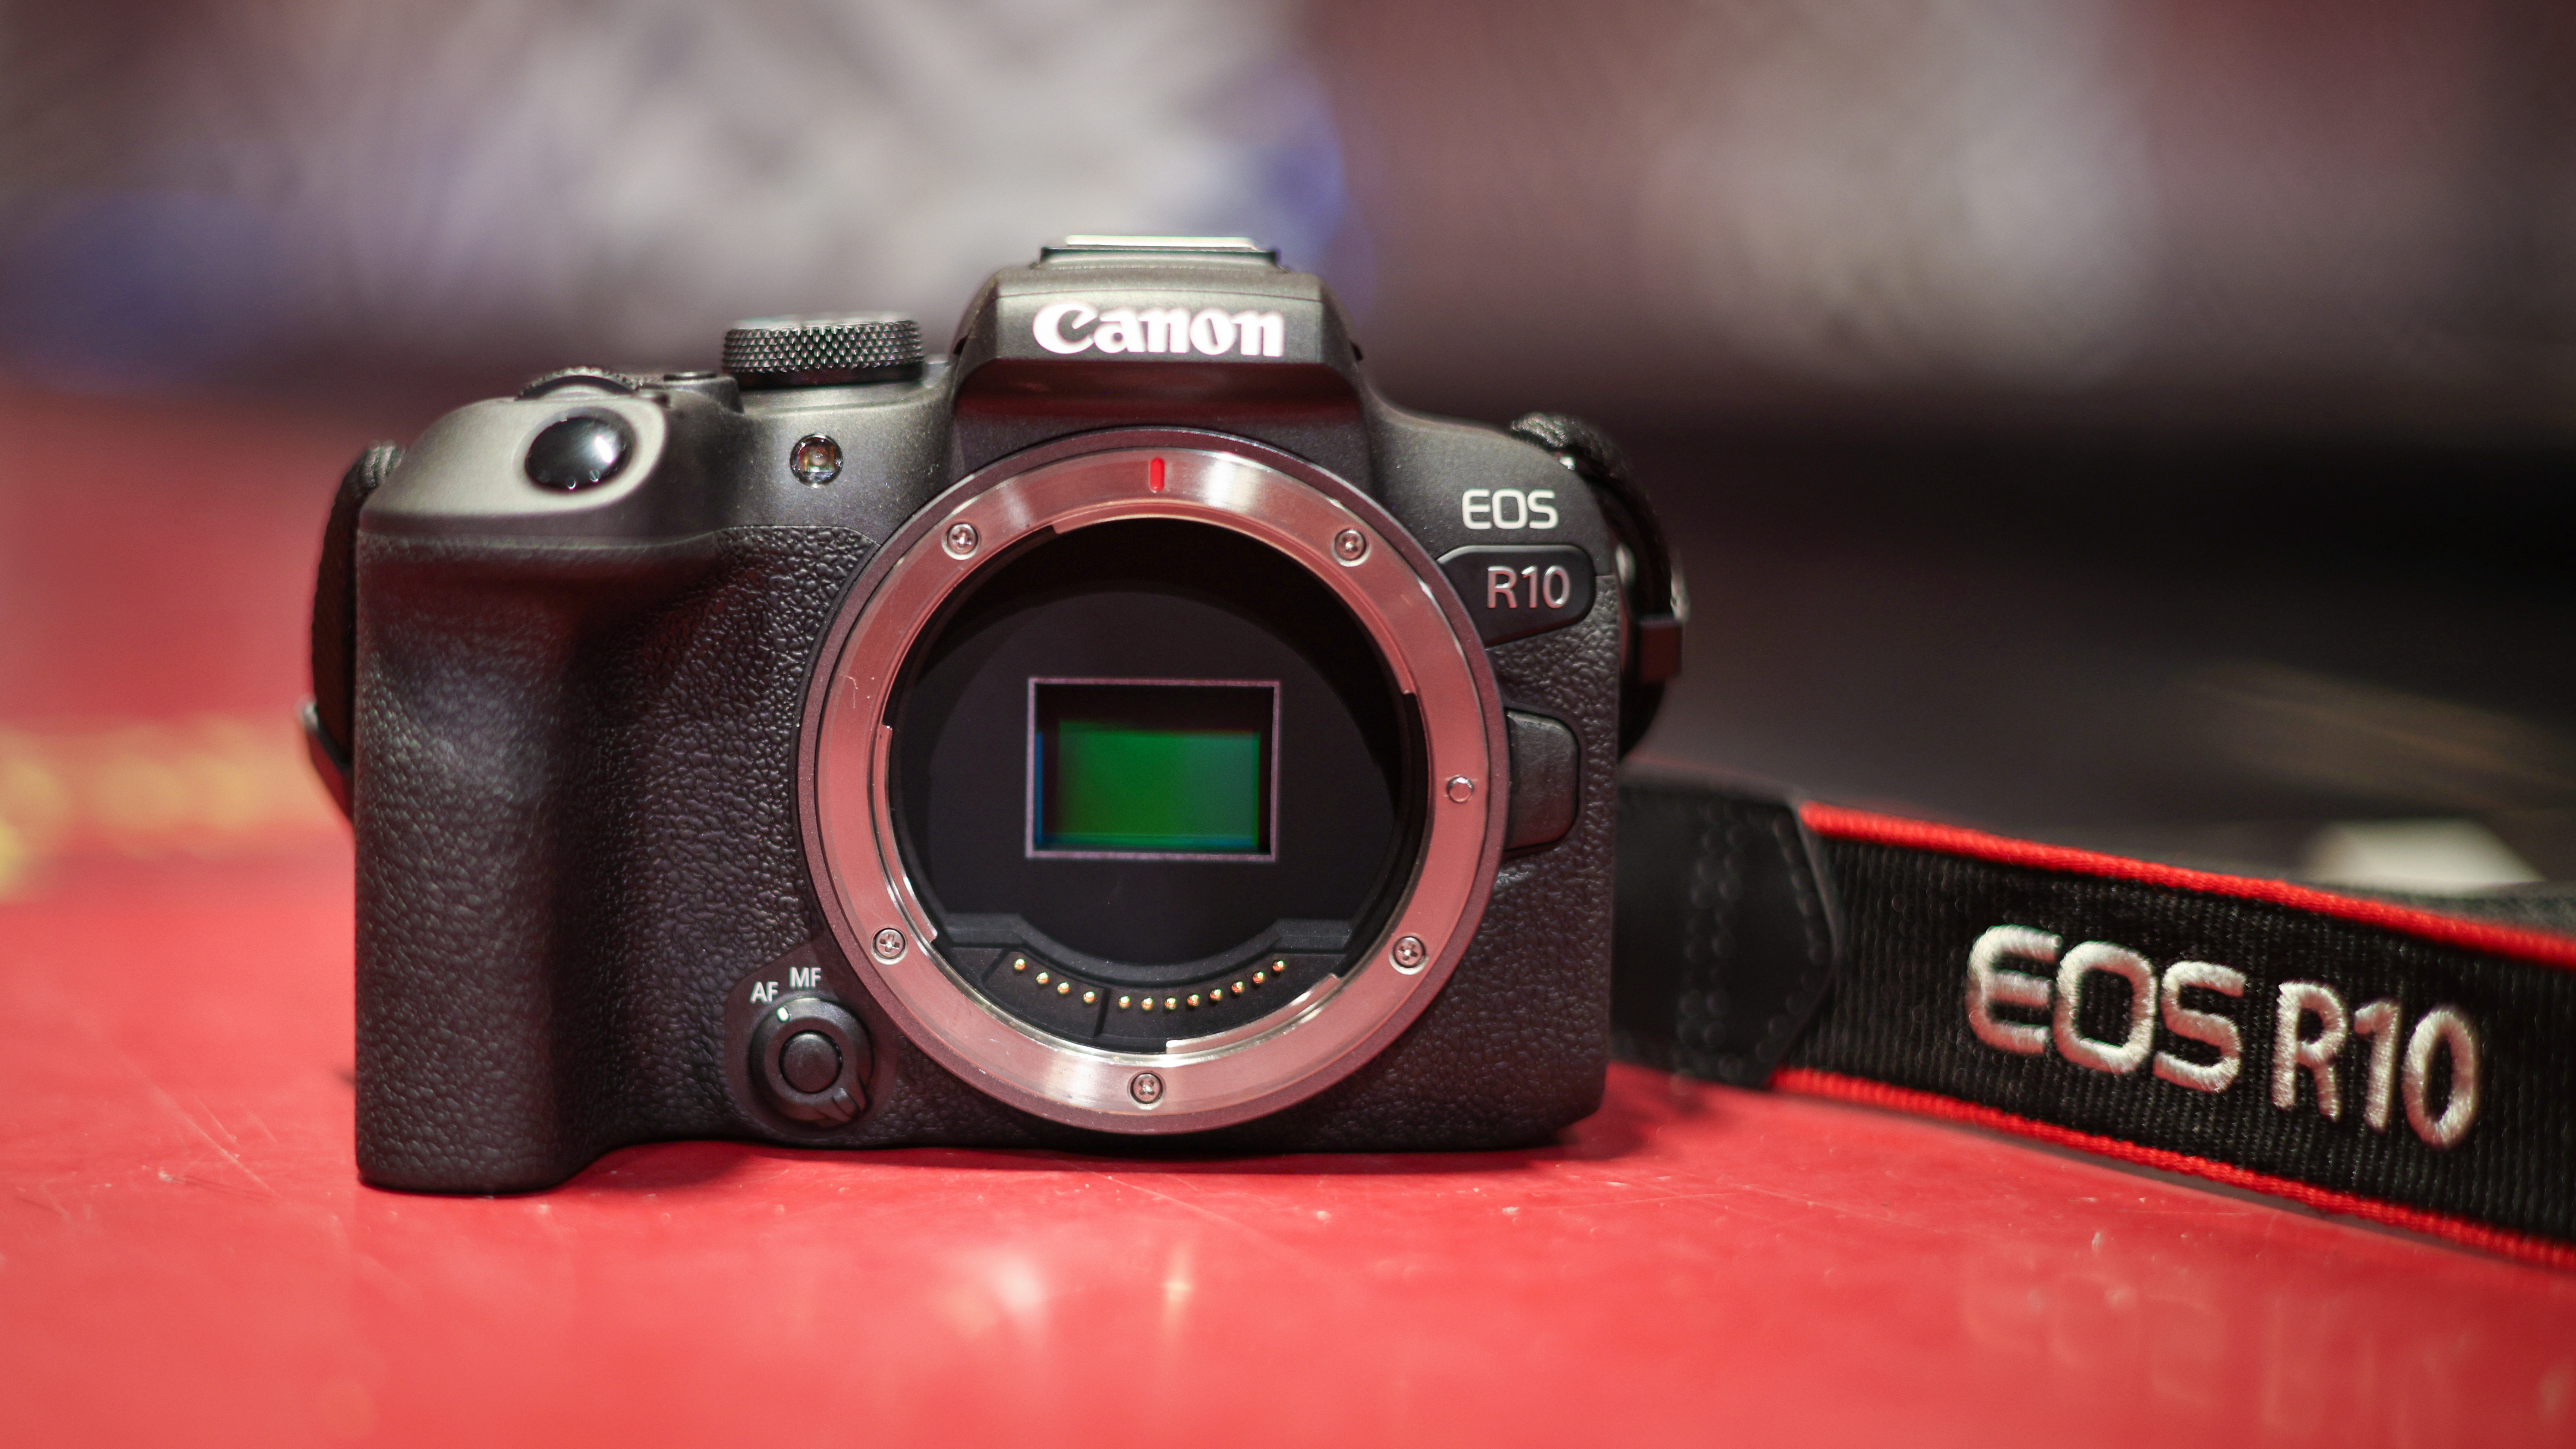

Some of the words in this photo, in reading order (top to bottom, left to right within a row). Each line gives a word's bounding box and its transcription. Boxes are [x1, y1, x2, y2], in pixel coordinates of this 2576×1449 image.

[1033, 303, 1285, 357] Canon
[1462, 488, 1559, 529] EOS
[1487, 565, 1571, 609] R10
[750, 981, 778, 1004] AF
[790, 967, 821, 988] MF
[1965, 924, 2246, 1093] EOS
[2273, 981, 2481, 1150] R10
